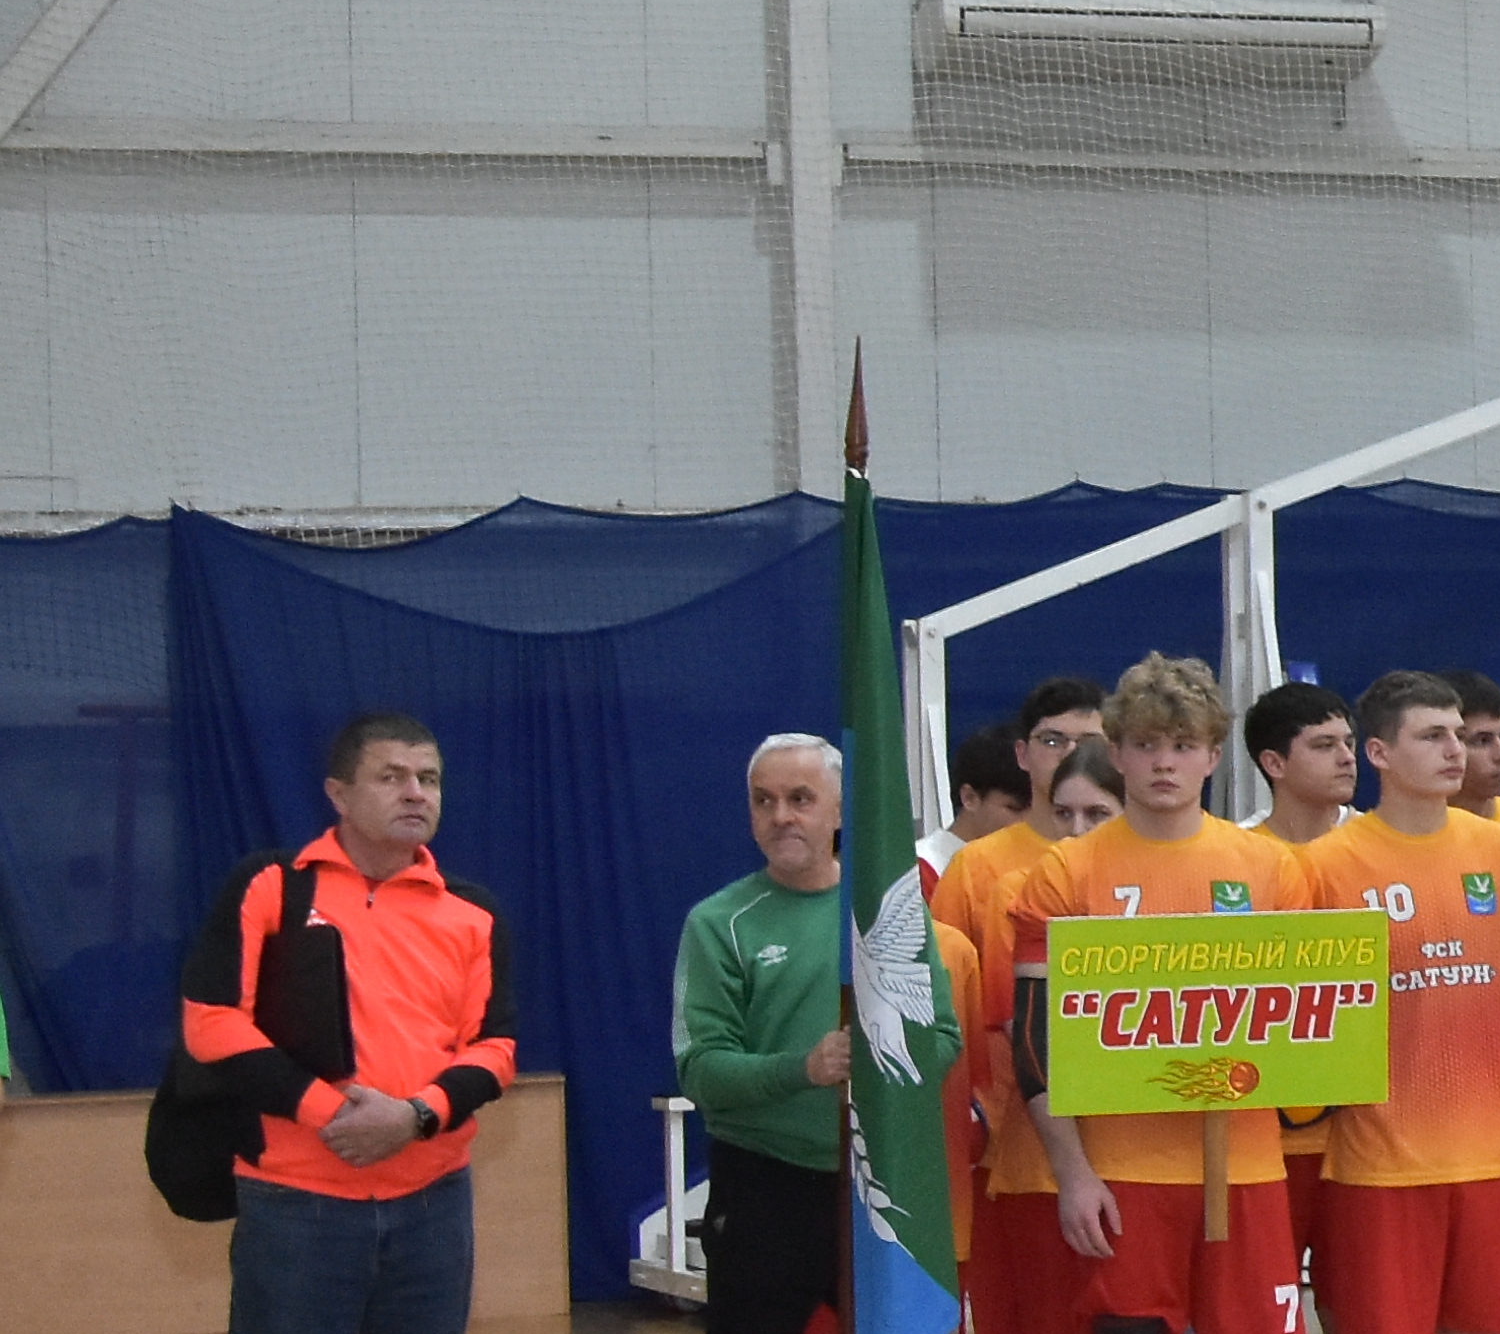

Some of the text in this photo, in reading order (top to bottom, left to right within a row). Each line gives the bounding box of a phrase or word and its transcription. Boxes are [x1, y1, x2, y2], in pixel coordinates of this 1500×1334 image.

[1113, 884, 1142, 918] 7
[1362, 882, 1416, 922] 10
[1059, 933, 1378, 978] СПОРТИВНЫЙ КЛУБ
[1420, 940, 1465, 959] ФСК
[1275, 1283, 1299, 1334] 7
